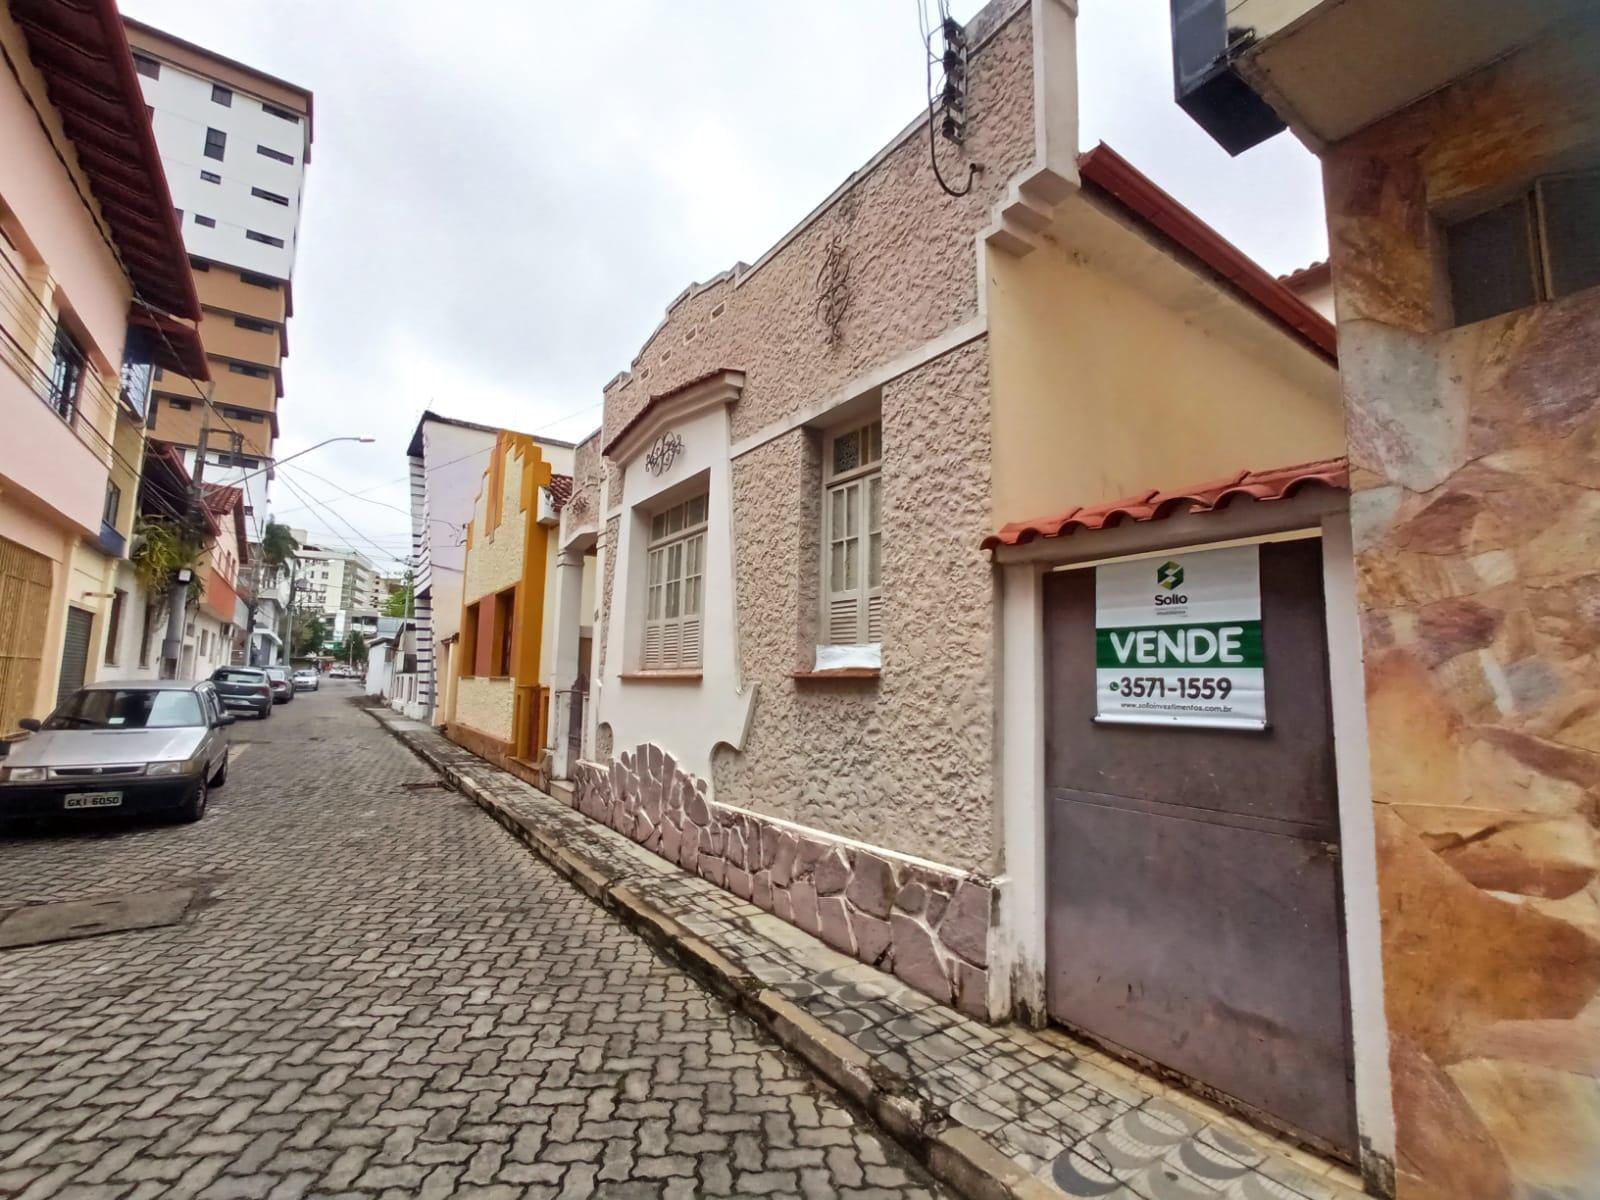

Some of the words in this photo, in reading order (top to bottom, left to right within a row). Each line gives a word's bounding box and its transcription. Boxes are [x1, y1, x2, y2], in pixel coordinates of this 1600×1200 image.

[1154, 594, 1188, 606] Sollo
[1110, 627, 1244, 663] VENDE
[1121, 676, 1232, 700] 3571-1559
